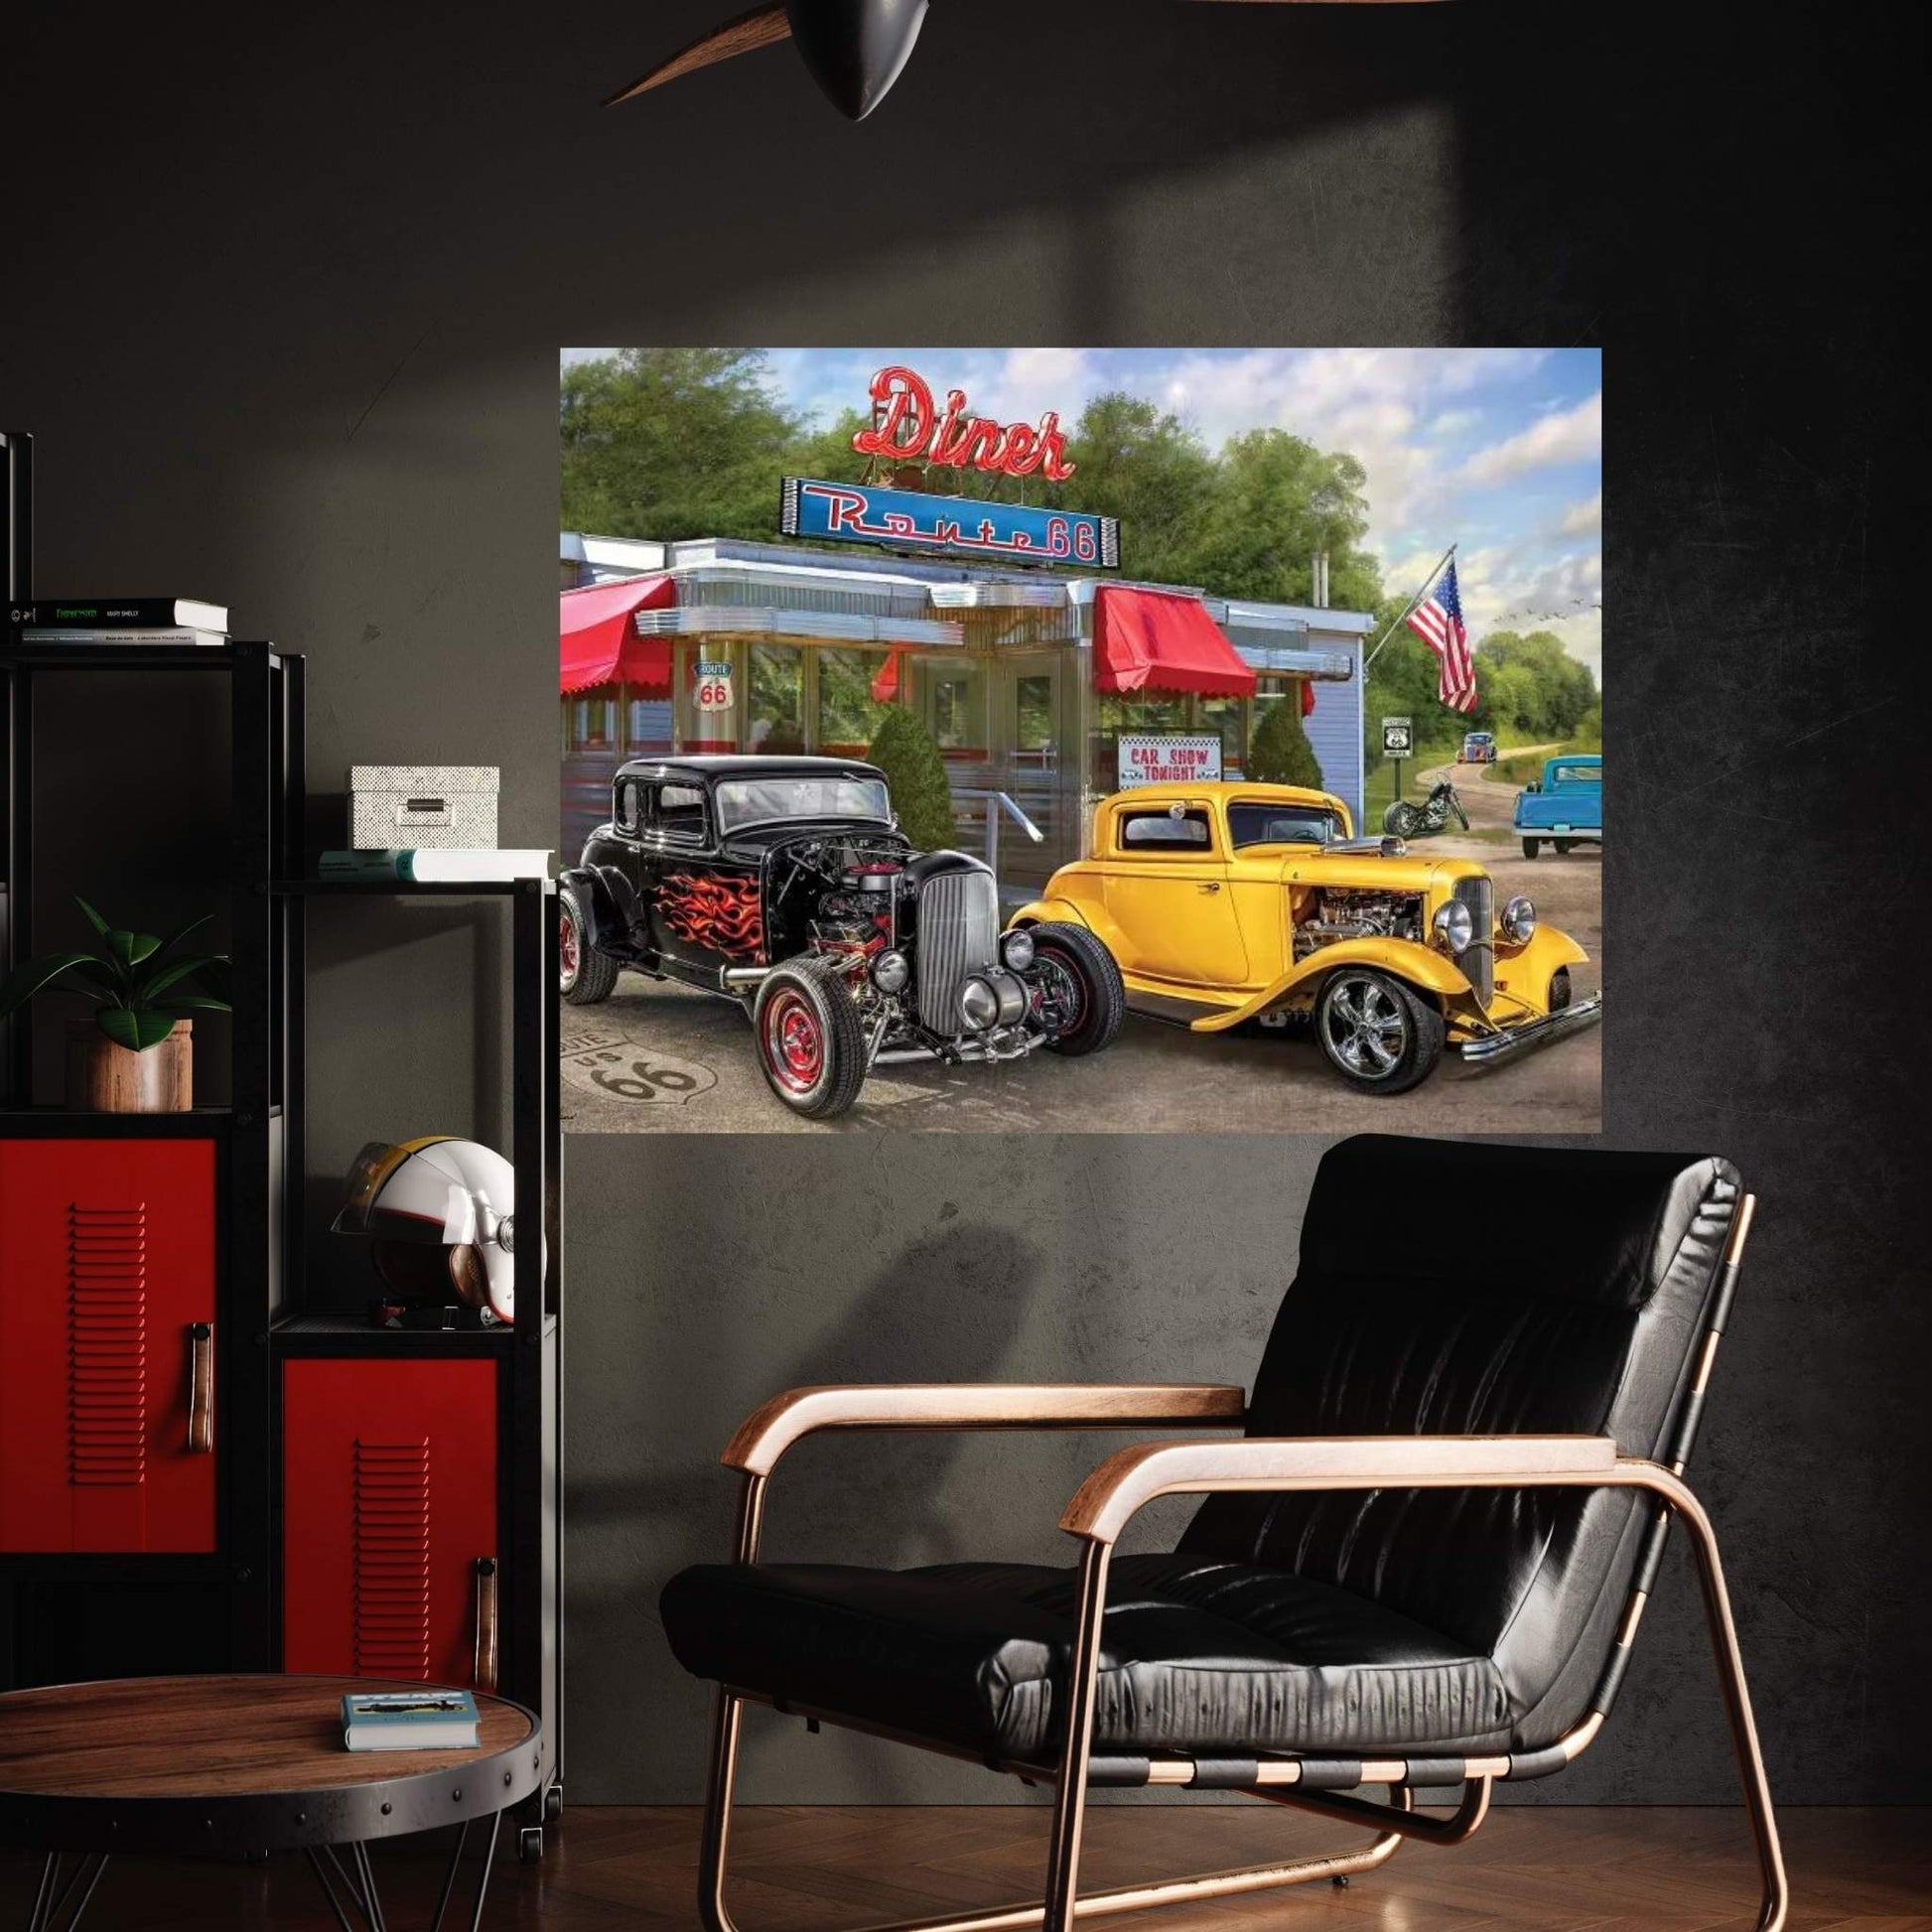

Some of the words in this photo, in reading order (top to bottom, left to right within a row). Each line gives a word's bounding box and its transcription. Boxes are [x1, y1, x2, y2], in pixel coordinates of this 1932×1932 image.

[852, 366, 1076, 482] Diner
[803, 484, 1050, 556] Route
[1046, 517, 1096, 560] 66
[700, 685, 726, 704] 66
[1131, 749, 1159, 764] CAR
[1170, 749, 1209, 764] SHOW
[1144, 765, 1196, 780] TONIGHT
[590, 1061, 697, 1099] 66
